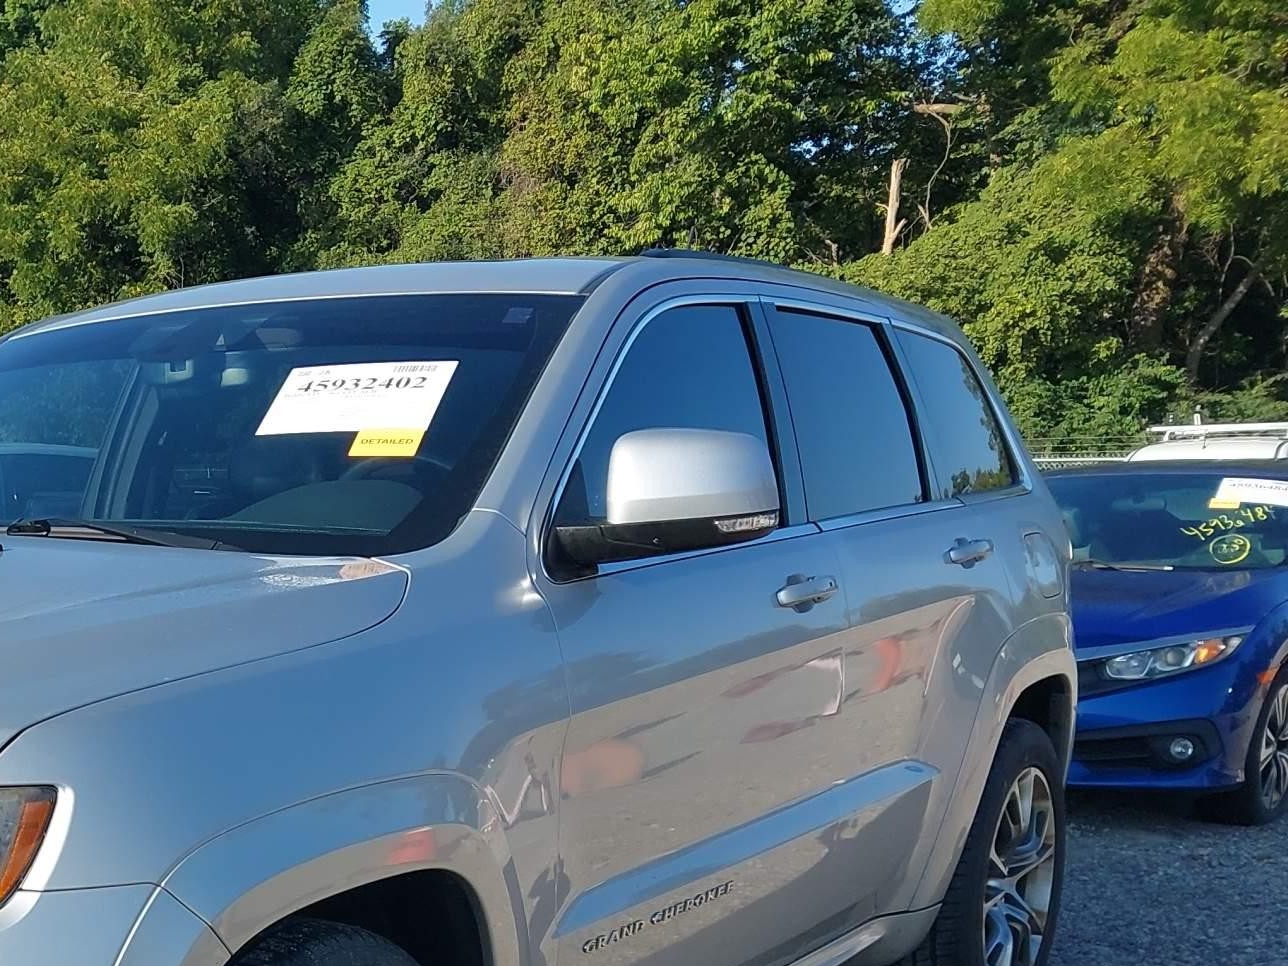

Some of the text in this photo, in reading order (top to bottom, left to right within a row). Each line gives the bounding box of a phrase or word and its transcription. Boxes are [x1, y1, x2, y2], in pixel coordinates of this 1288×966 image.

[298, 376, 428, 393] 45932402
[582, 879, 735, 954] GRAND CHEROKEE
